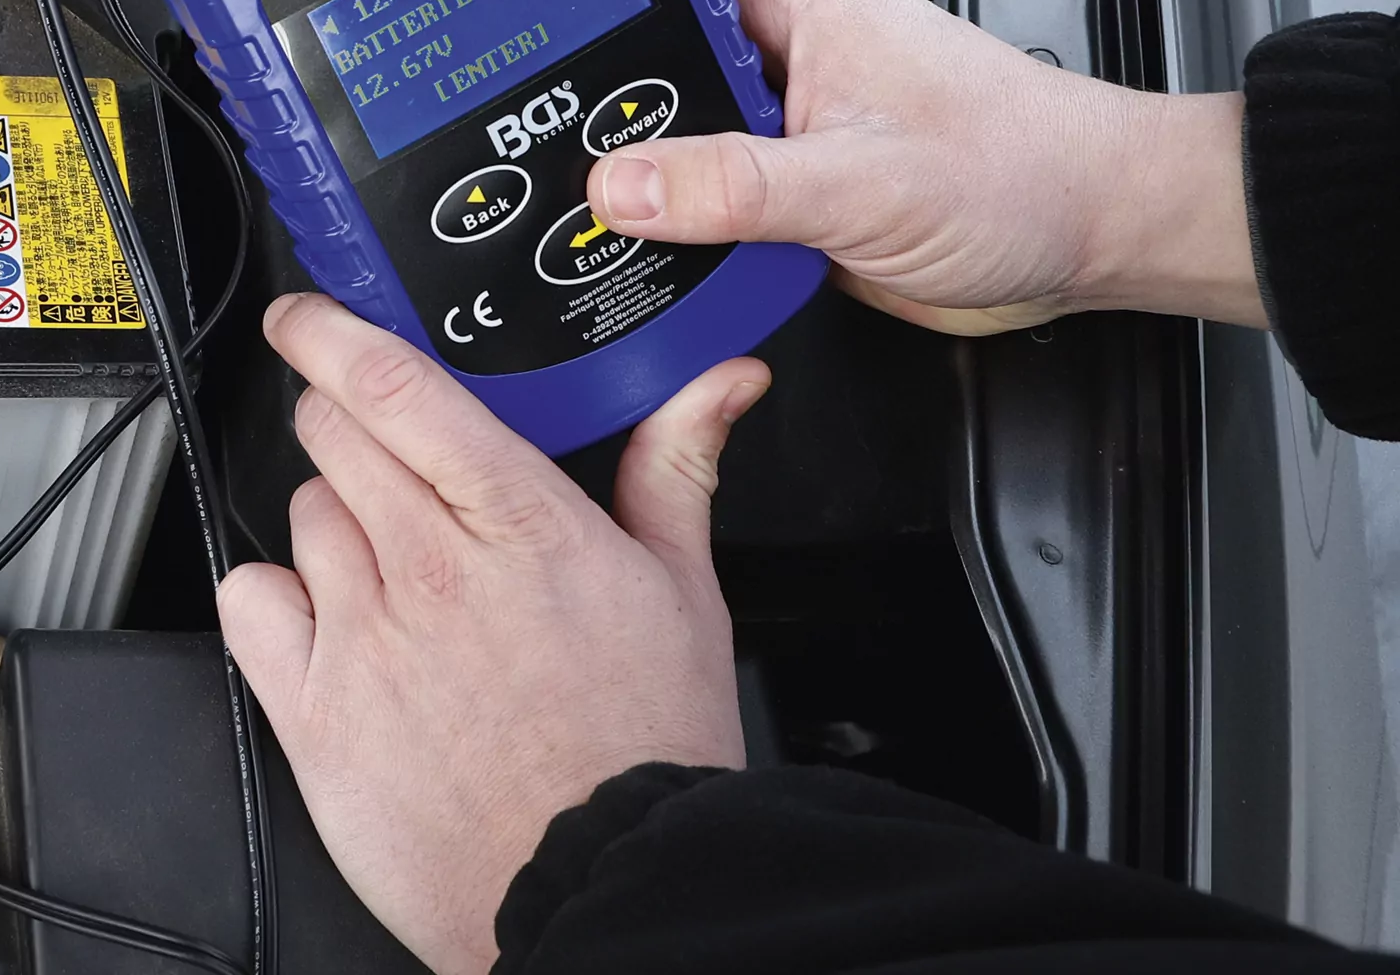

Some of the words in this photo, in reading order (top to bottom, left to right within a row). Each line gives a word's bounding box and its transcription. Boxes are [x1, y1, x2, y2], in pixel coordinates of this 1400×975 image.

[352, 35, 454, 107] 12.67V
[433, 21, 550, 102] [ENTER]
[103, 91, 111, 104] 12V
[486, 86, 580, 159] BGS
[536, 111, 587, 144] technic
[601, 101, 670, 150] Forward
[462, 197, 512, 231] Back
[574, 236, 628, 272] Enter
[118, 262, 137, 303] DANGER
[560, 299, 594, 322] Fabriqué
[594, 266, 655, 303] pour/Producido
[654, 253, 675, 271] para:
[568, 280, 612, 308] Hergestellt
[611, 260, 647, 283] für/Made
[646, 253, 658, 262] for
[598, 298, 616, 310] BGS
[616, 282, 645, 300] technic
[66, 305, 113, 323] 危険
[444, 290, 503, 343] CE
[591, 294, 673, 343] www.bgstechnic.com
[594, 288, 650, 322] Bandwirkerstr.
[614, 284, 675, 321] Wermelskirchen
